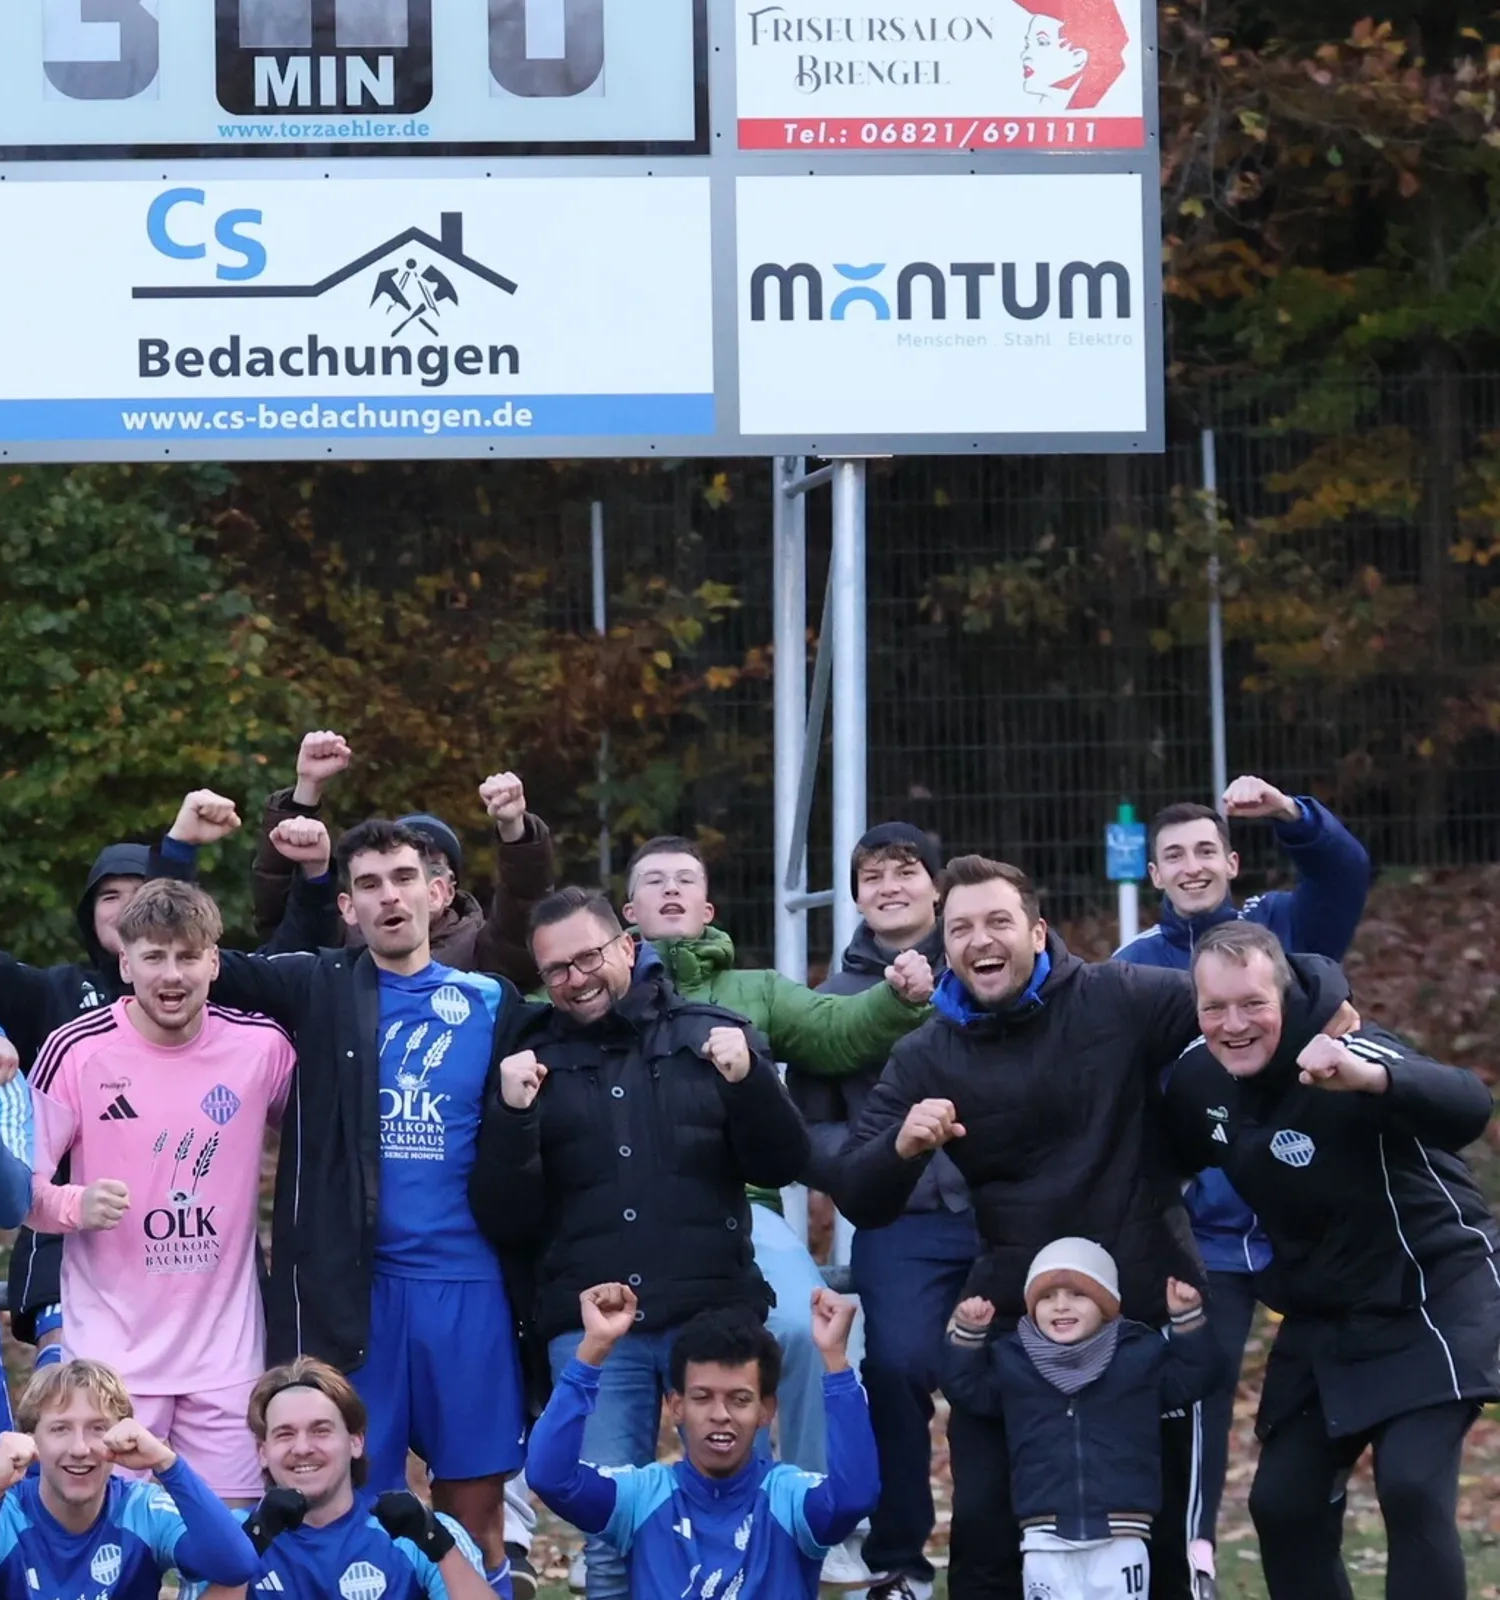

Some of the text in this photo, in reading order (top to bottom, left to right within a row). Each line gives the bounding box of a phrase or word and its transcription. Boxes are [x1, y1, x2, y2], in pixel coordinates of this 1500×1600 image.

[254, 56, 395, 107] MIN
[218, 120, 430, 138] www.torzaehler.de
[784, 121, 1098, 148] Tel.: 06821/691111
[896, 331, 1133, 348] Menschen Stahl Elektro
[137, 334, 521, 388] Bedachungen
[122, 402, 534, 436] www.cs-bedachungen.de
[380, 1121, 445, 1134] OLLKORN
[380, 1132, 444, 1146] ACKHAUS
[143, 1205, 217, 1240] OLK
[145, 1240, 220, 1253] VOLLKORN
[1121, 1563, 1144, 1595] 10
